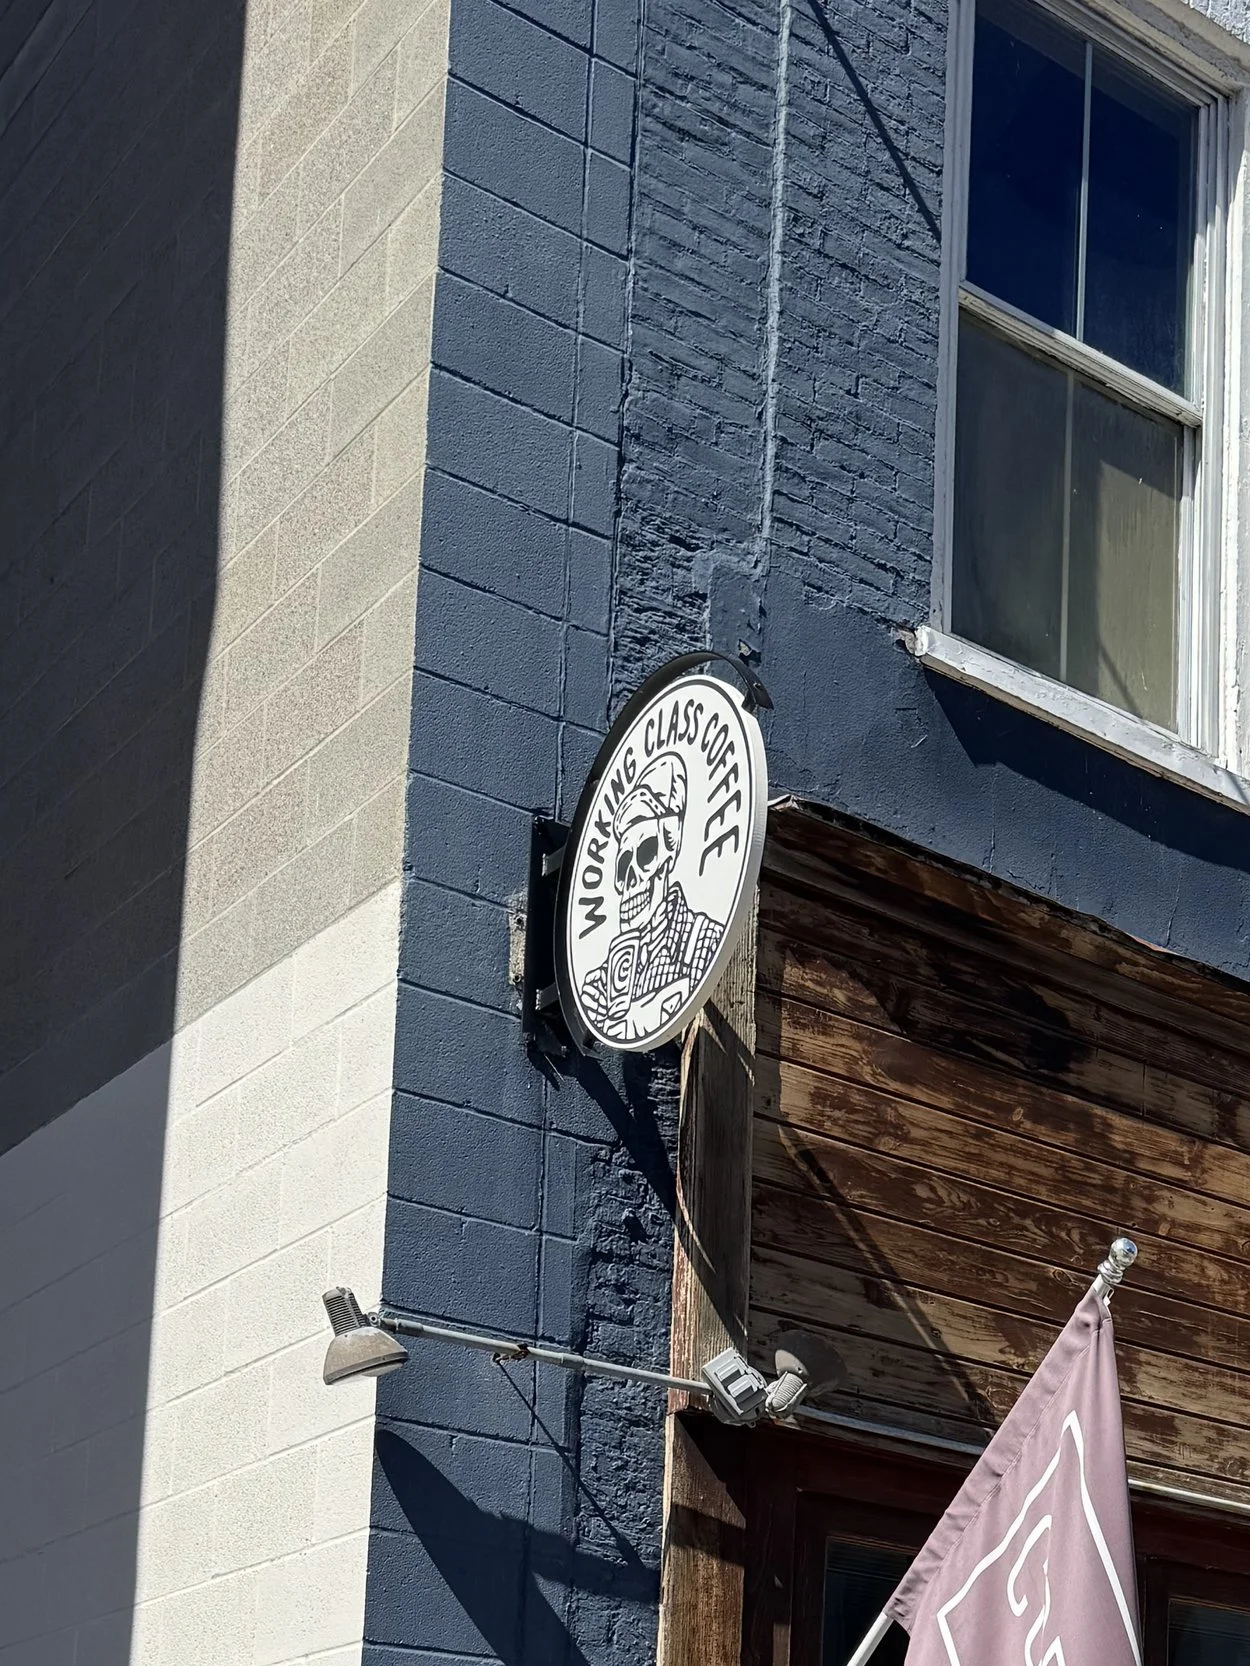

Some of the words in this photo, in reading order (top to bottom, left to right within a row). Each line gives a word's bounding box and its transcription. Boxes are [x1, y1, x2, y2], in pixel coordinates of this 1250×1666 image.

[578, 746, 638, 940] WORKING
[644, 698, 705, 753] CLASS
[700, 711, 744, 877] COFFEE
